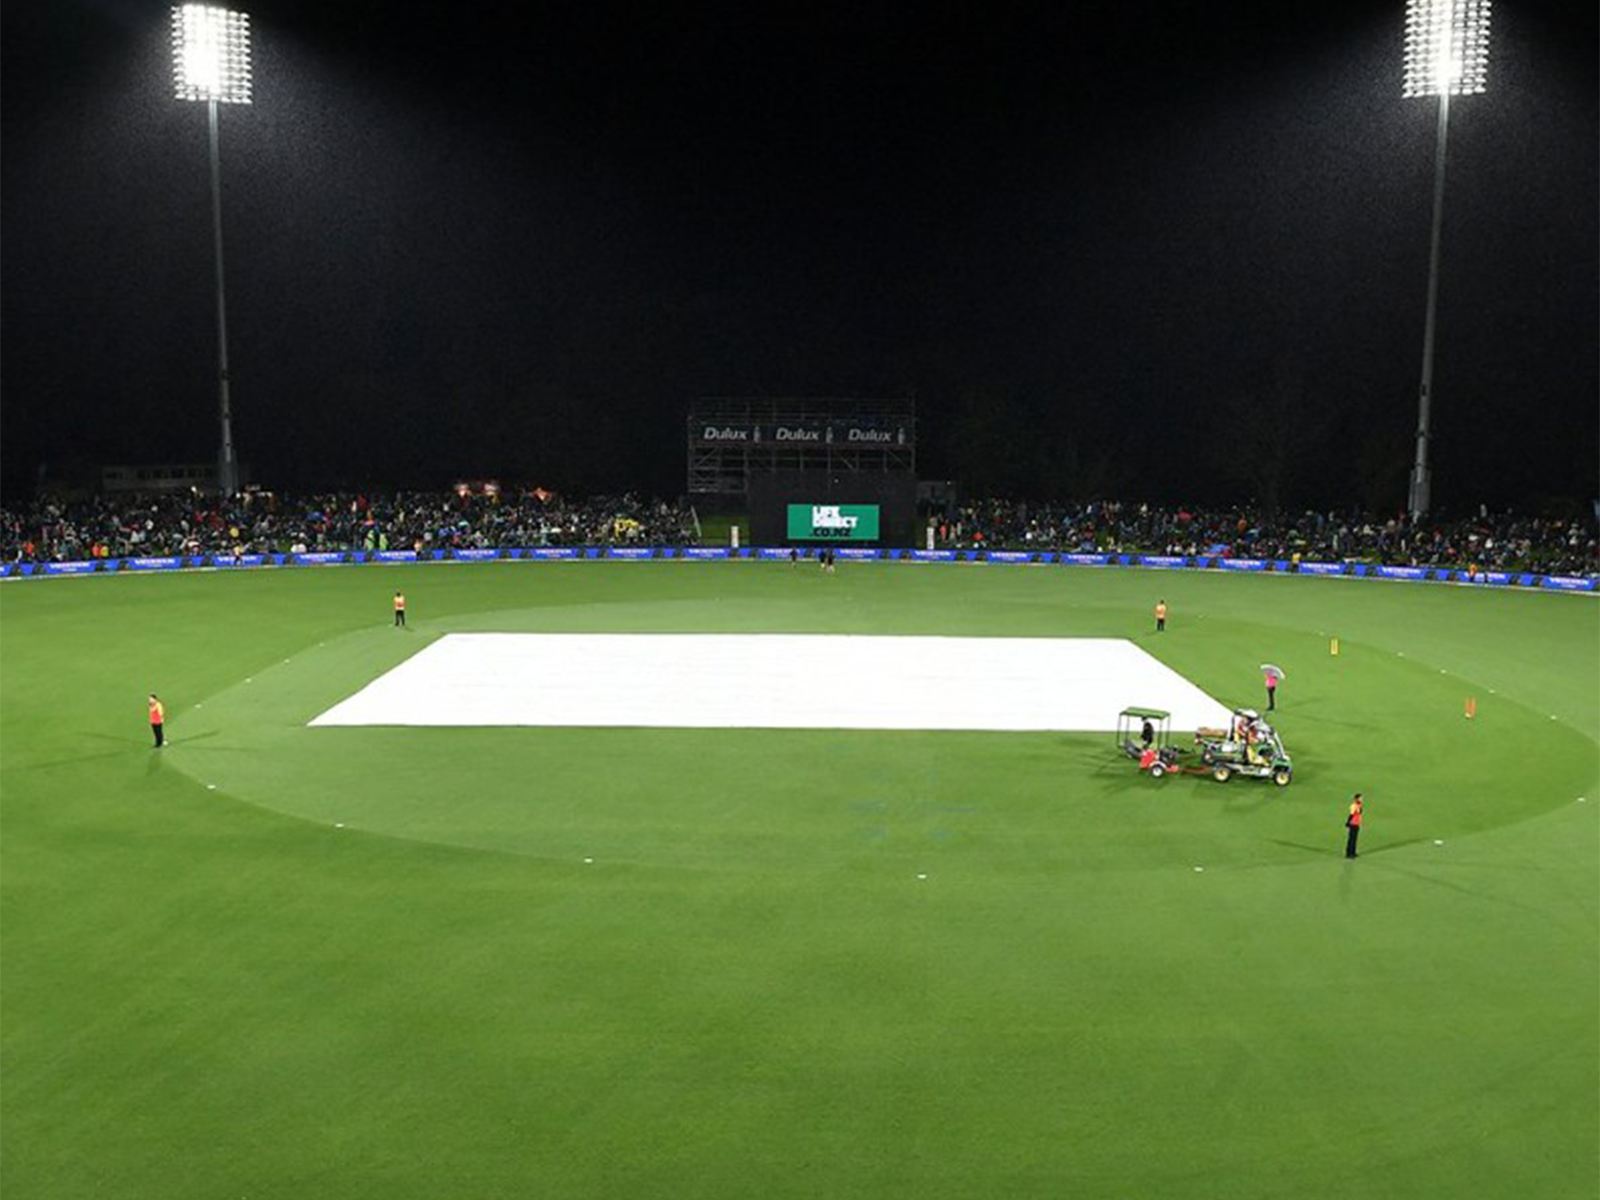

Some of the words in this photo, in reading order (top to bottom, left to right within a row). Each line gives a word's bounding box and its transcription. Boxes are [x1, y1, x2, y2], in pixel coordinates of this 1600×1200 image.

[704, 427, 747, 440] Dulux
[776, 428, 819, 440] Dulux
[848, 428, 891, 441] Dulux
